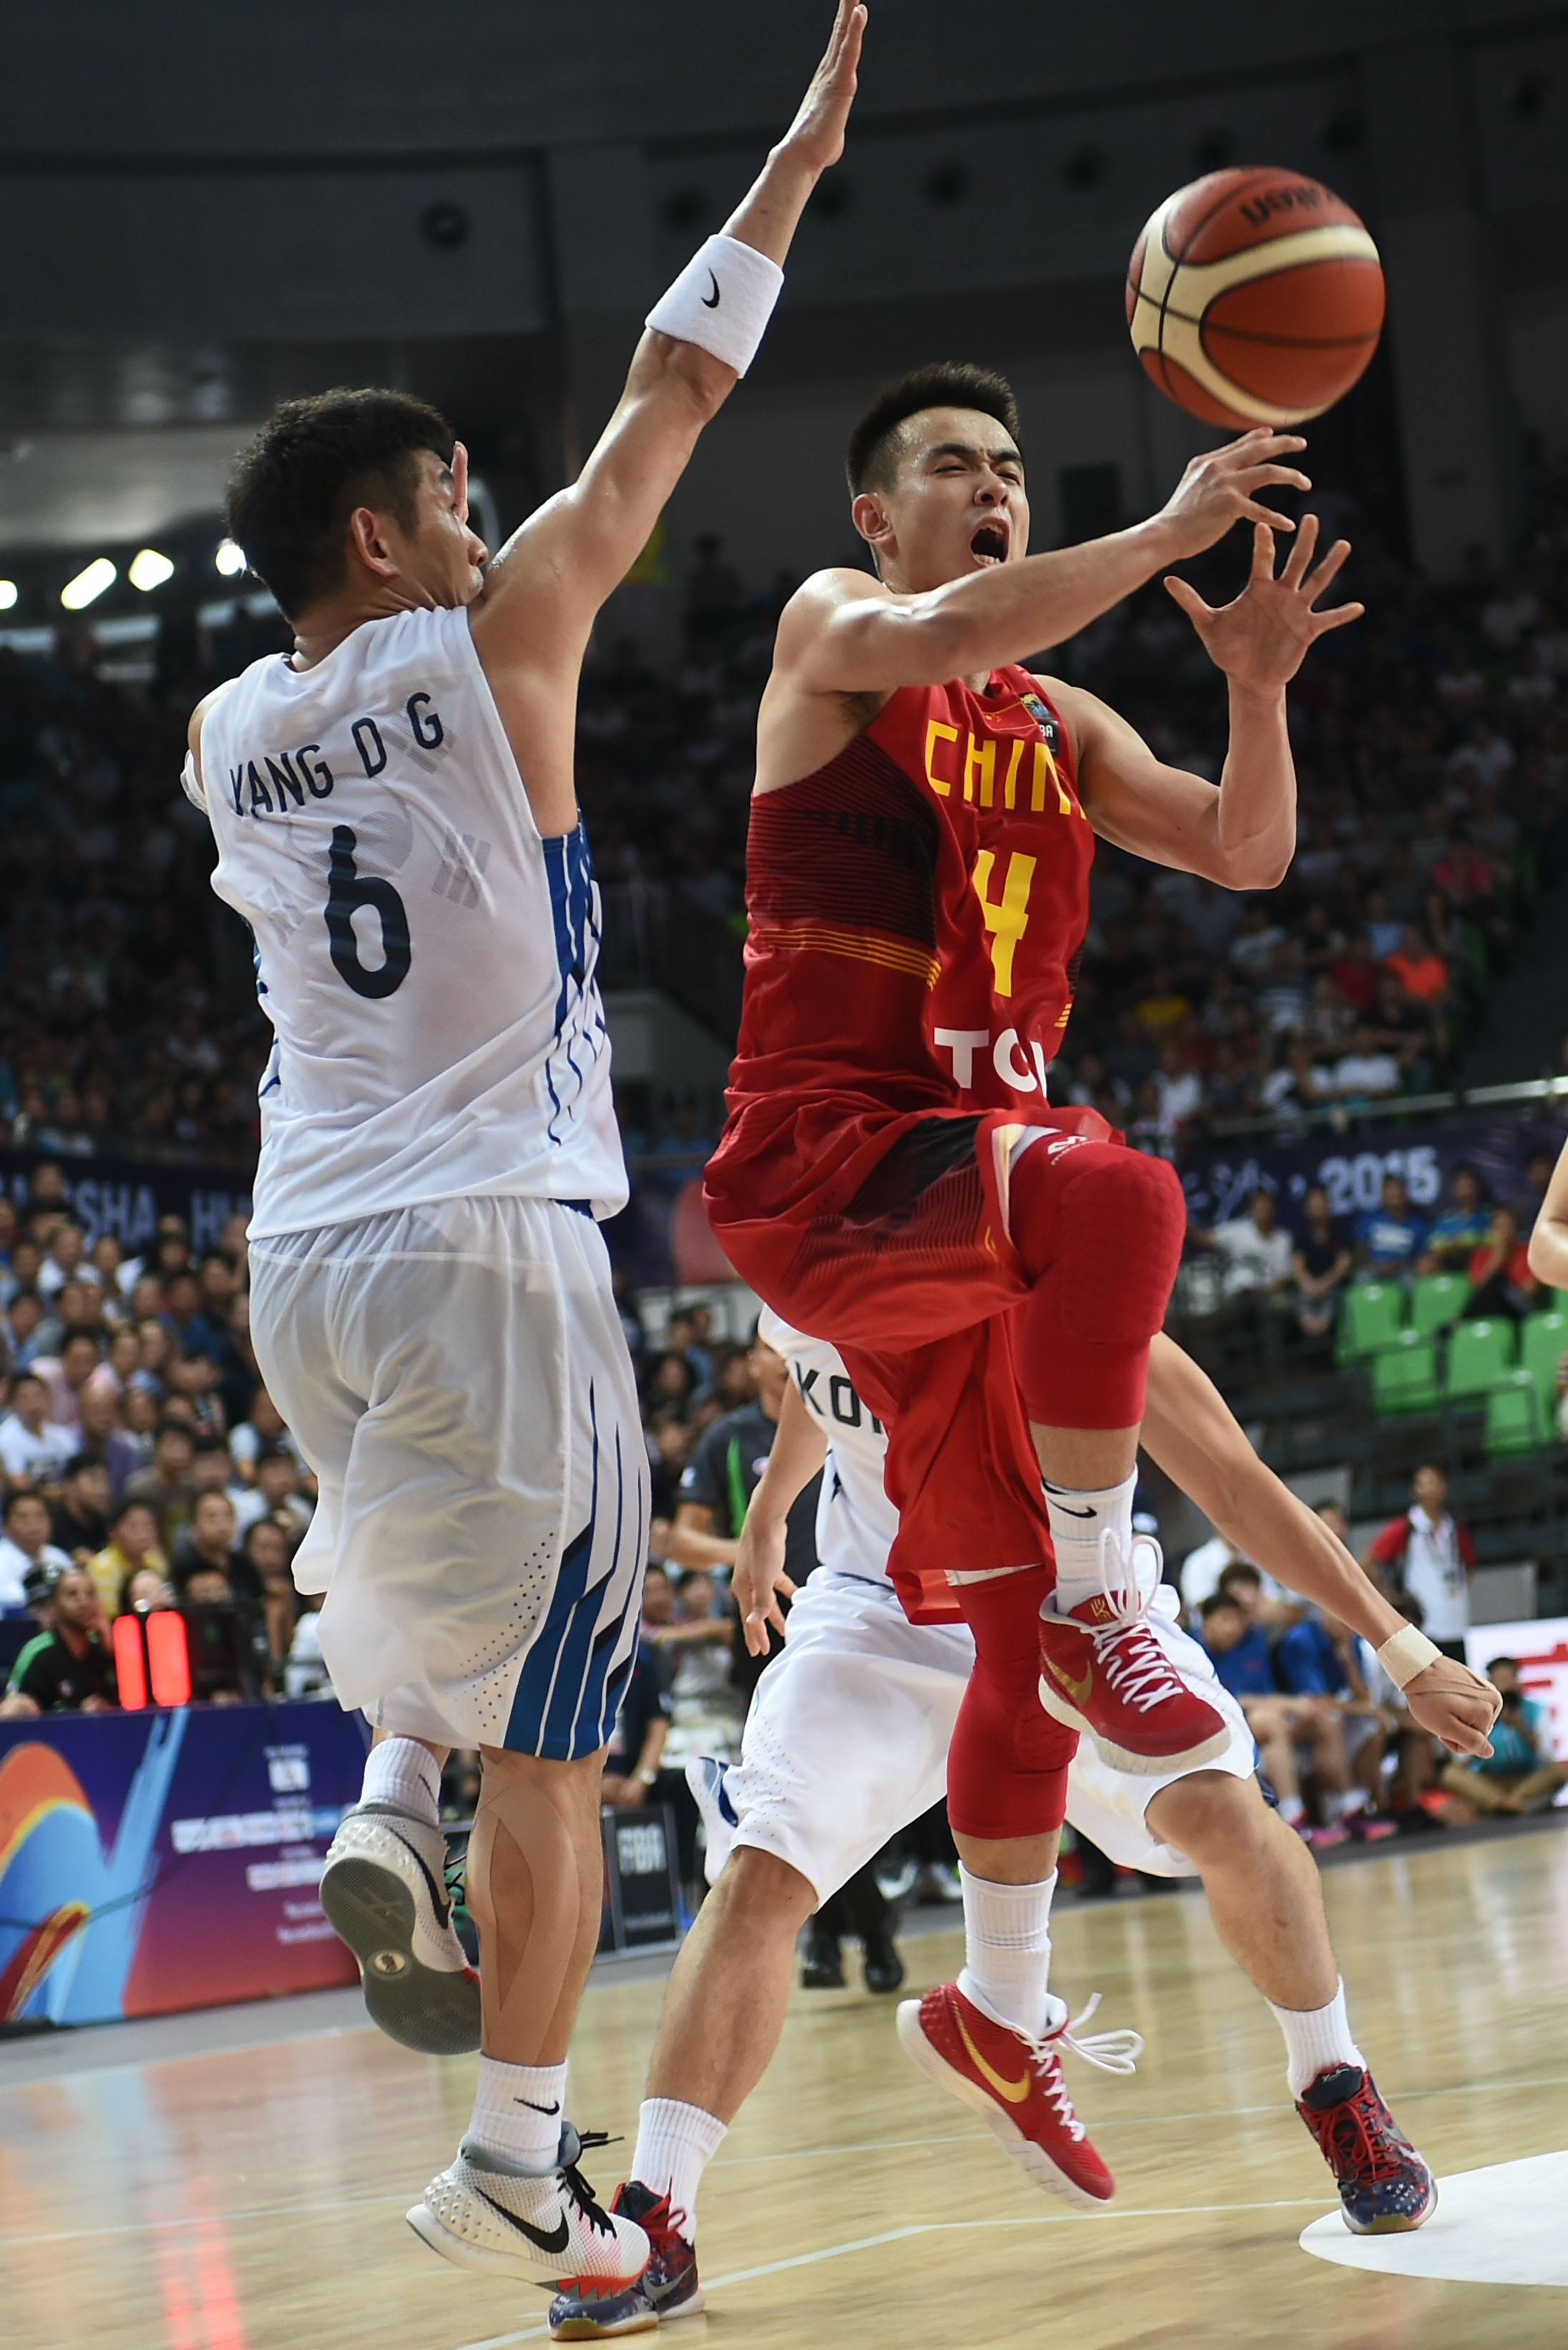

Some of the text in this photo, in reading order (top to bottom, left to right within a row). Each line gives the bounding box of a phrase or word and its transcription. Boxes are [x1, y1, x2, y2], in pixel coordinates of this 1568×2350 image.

[230, 691, 444, 818] YANG D G
[925, 719, 1087, 820] CHIN
[324, 825, 412, 999] 6
[972, 850, 1036, 997] 4
[795, 1361, 883, 1434] KO
